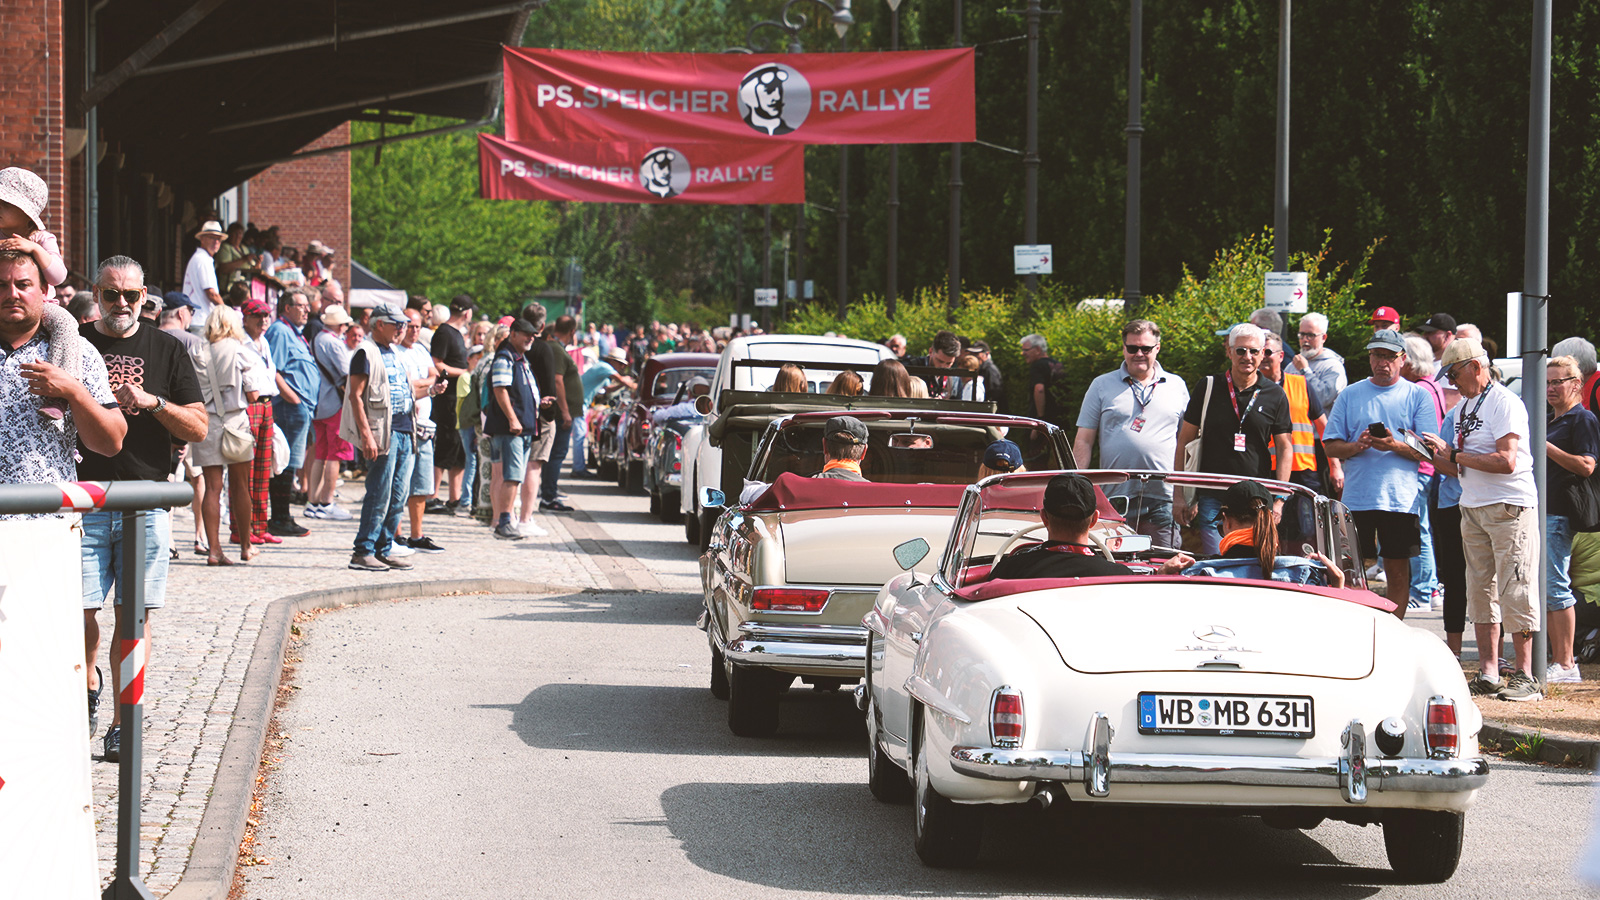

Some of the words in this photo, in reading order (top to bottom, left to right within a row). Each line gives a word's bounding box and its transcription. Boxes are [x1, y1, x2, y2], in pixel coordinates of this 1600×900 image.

[537, 84, 729, 112] PS.SPEICHER
[819, 88, 931, 112] RALLYE
[500, 159, 634, 183] PS.SPEICHER
[695, 166, 774, 183] RALLYE
[1145, 714, 1152, 723] D
[1158, 698, 1195, 725] WB
[1214, 699, 1250, 726] MB
[1257, 701, 1310, 728] 63H
